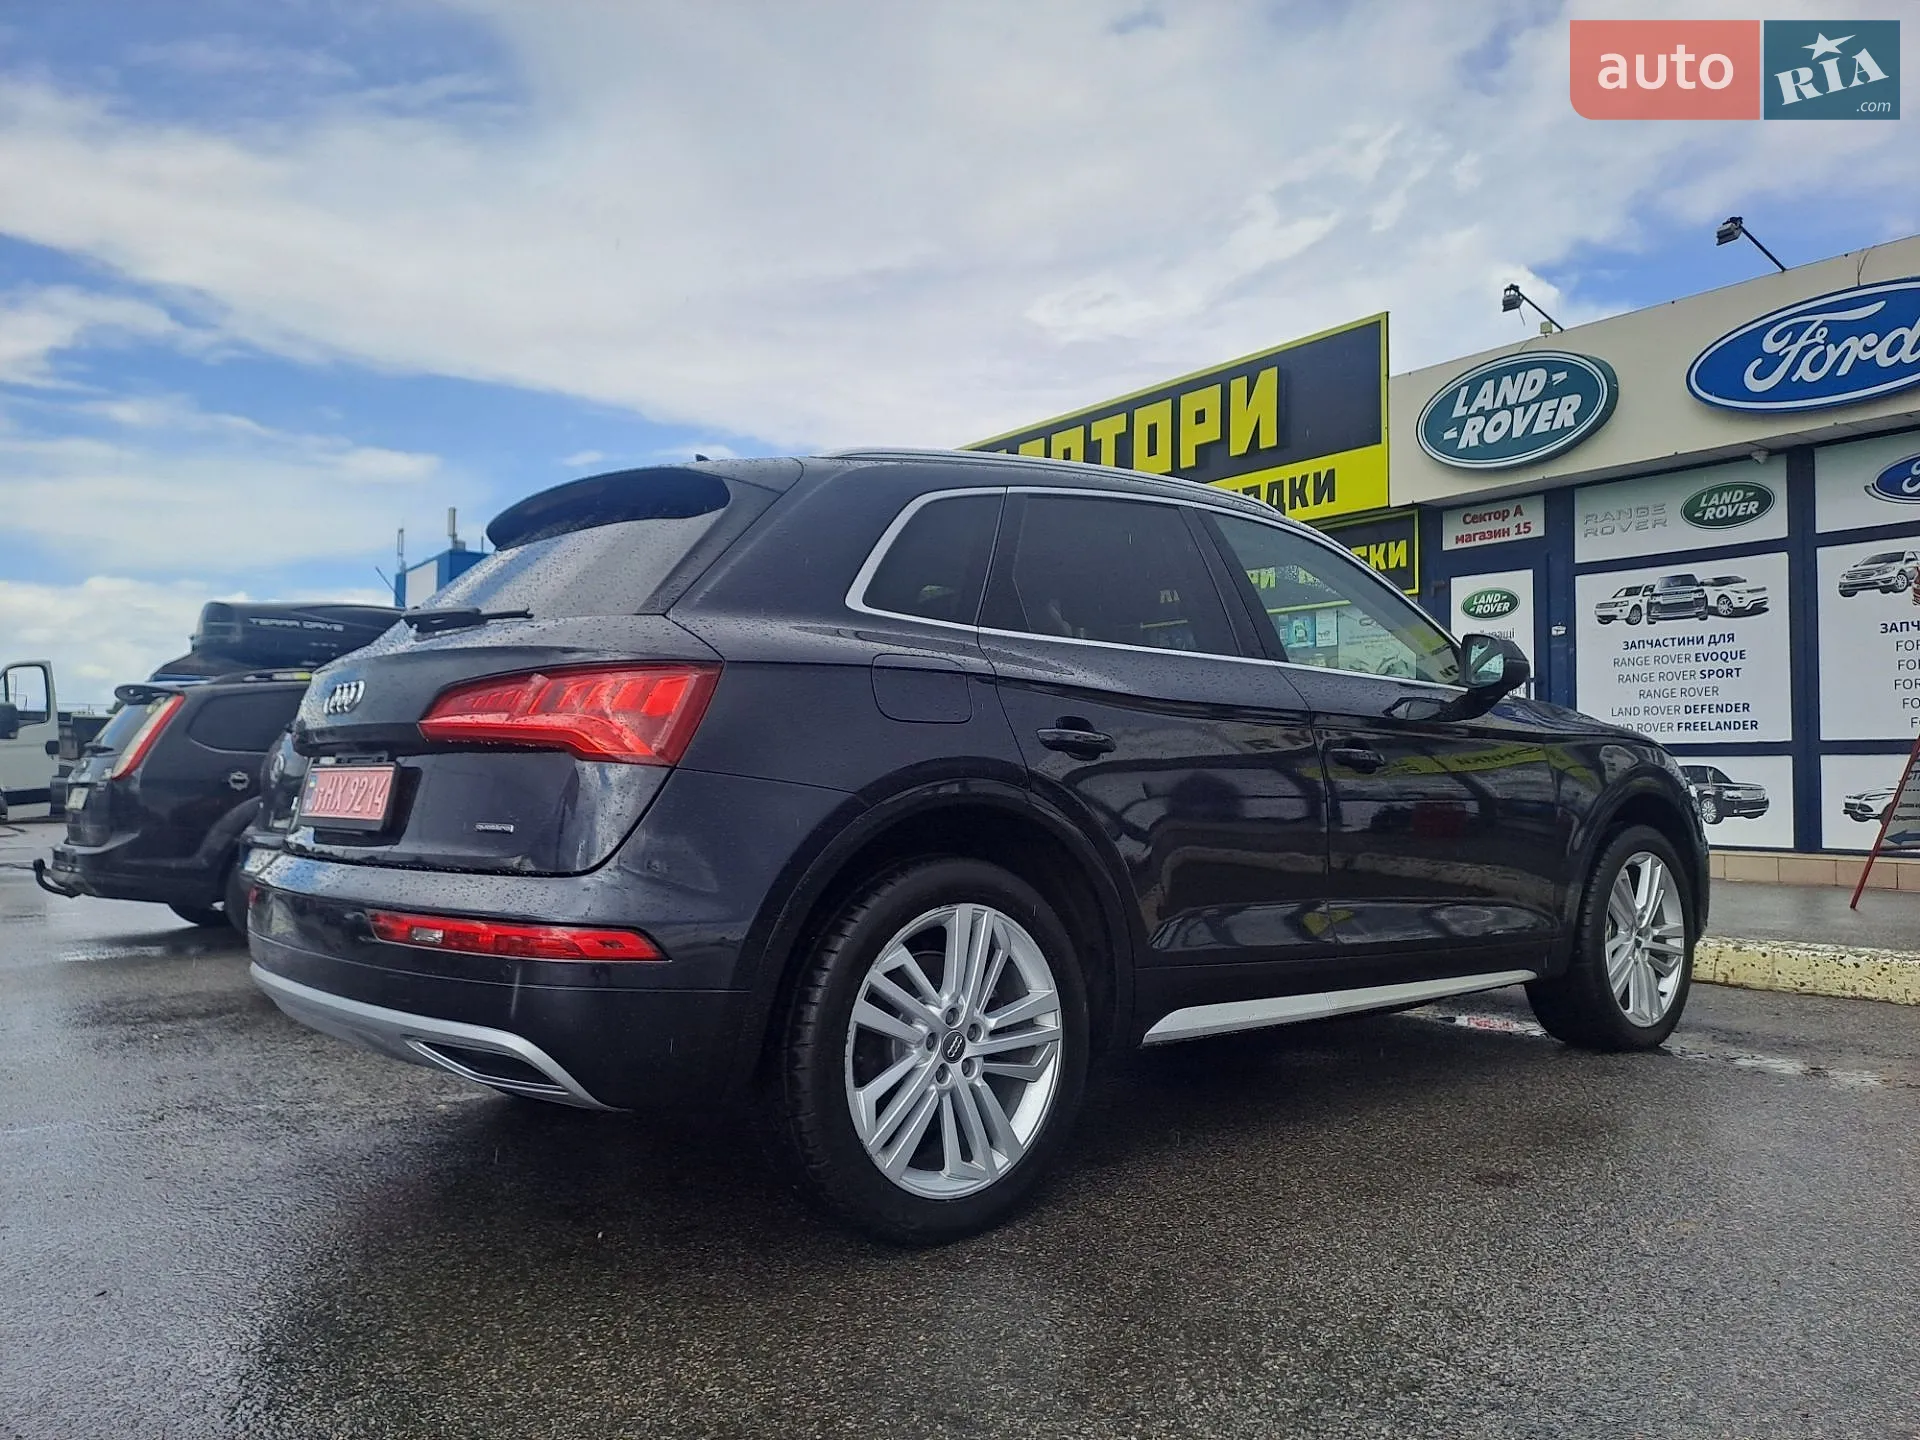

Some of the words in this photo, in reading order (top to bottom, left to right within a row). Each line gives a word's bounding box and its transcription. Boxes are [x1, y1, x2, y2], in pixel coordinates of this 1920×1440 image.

[1744, 300, 1920, 393] Ford
[1452, 368, 1548, 418] LAND
[1457, 393, 1582, 450] ROVER
[1700, 489, 1744, 508] LAND
[1462, 508, 1510, 525] Сектор
[1583, 503, 1666, 525] RANGE
[1703, 500, 1759, 520] ROVER
[1455, 527, 1511, 545] магазин
[1514, 521, 1532, 536] 15
[1583, 518, 1668, 538] ROVER
[1472, 593, 1501, 605] LAND
[1475, 602, 1511, 615] ROVER
[1622, 635, 1704, 651] ЗАПЧАСТИНИ
[1708, 632, 1736, 647] ДЛЯ
[1613, 655, 1651, 668] RANGE
[1653, 653, 1691, 666] ROVER
[1694, 649, 1747, 663] EVOQUE
[1898, 658, 1920, 671] FO
[1618, 672, 1655, 684] RANGE
[1658, 669, 1697, 682] ROVER
[1699, 667, 1742, 680] SPORT
[1638, 687, 1677, 700] RANGE
[1680, 685, 1720, 698] ROVER
[1611, 705, 1640, 717] LAND
[1643, 704, 1681, 716] ROVER
[1684, 702, 1750, 715] DEFENDER
[1637, 722, 1674, 733] ROVER
[1677, 720, 1759, 732] FREELANDER
[345, 776, 388, 814] 9214
